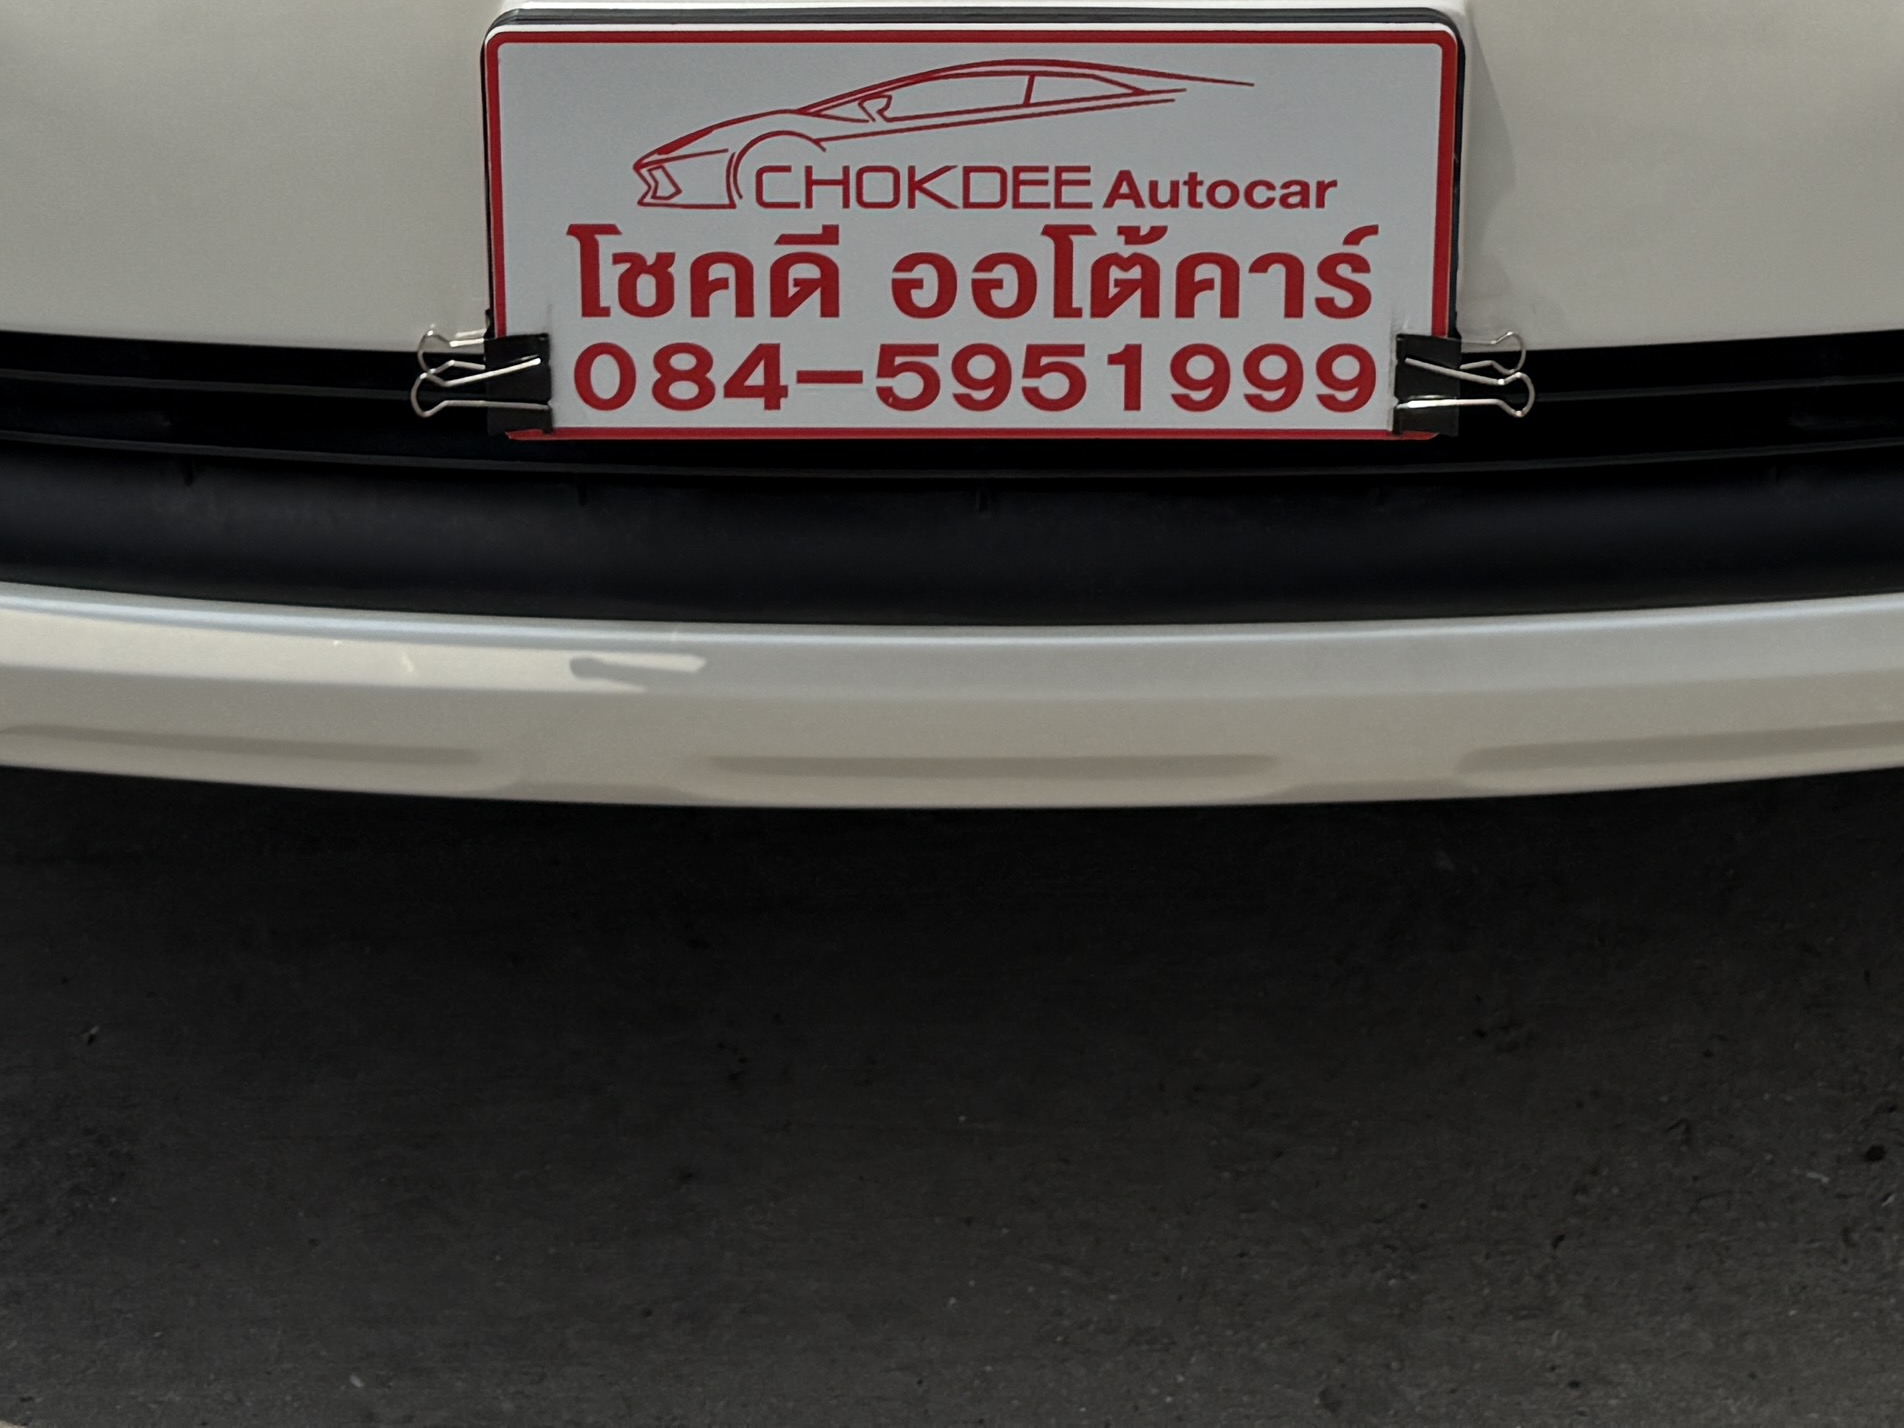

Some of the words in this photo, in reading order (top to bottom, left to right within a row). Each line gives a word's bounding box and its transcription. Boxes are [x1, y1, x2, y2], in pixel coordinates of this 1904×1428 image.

[754, 164, 1094, 210] CHOKDEE
[1102, 168, 1339, 210] Autocar
[565, 222, 841, 319] โชคดี
[890, 222, 1380, 320] ออโต้คาร์
[572, 341, 1378, 413] 084-5951999
